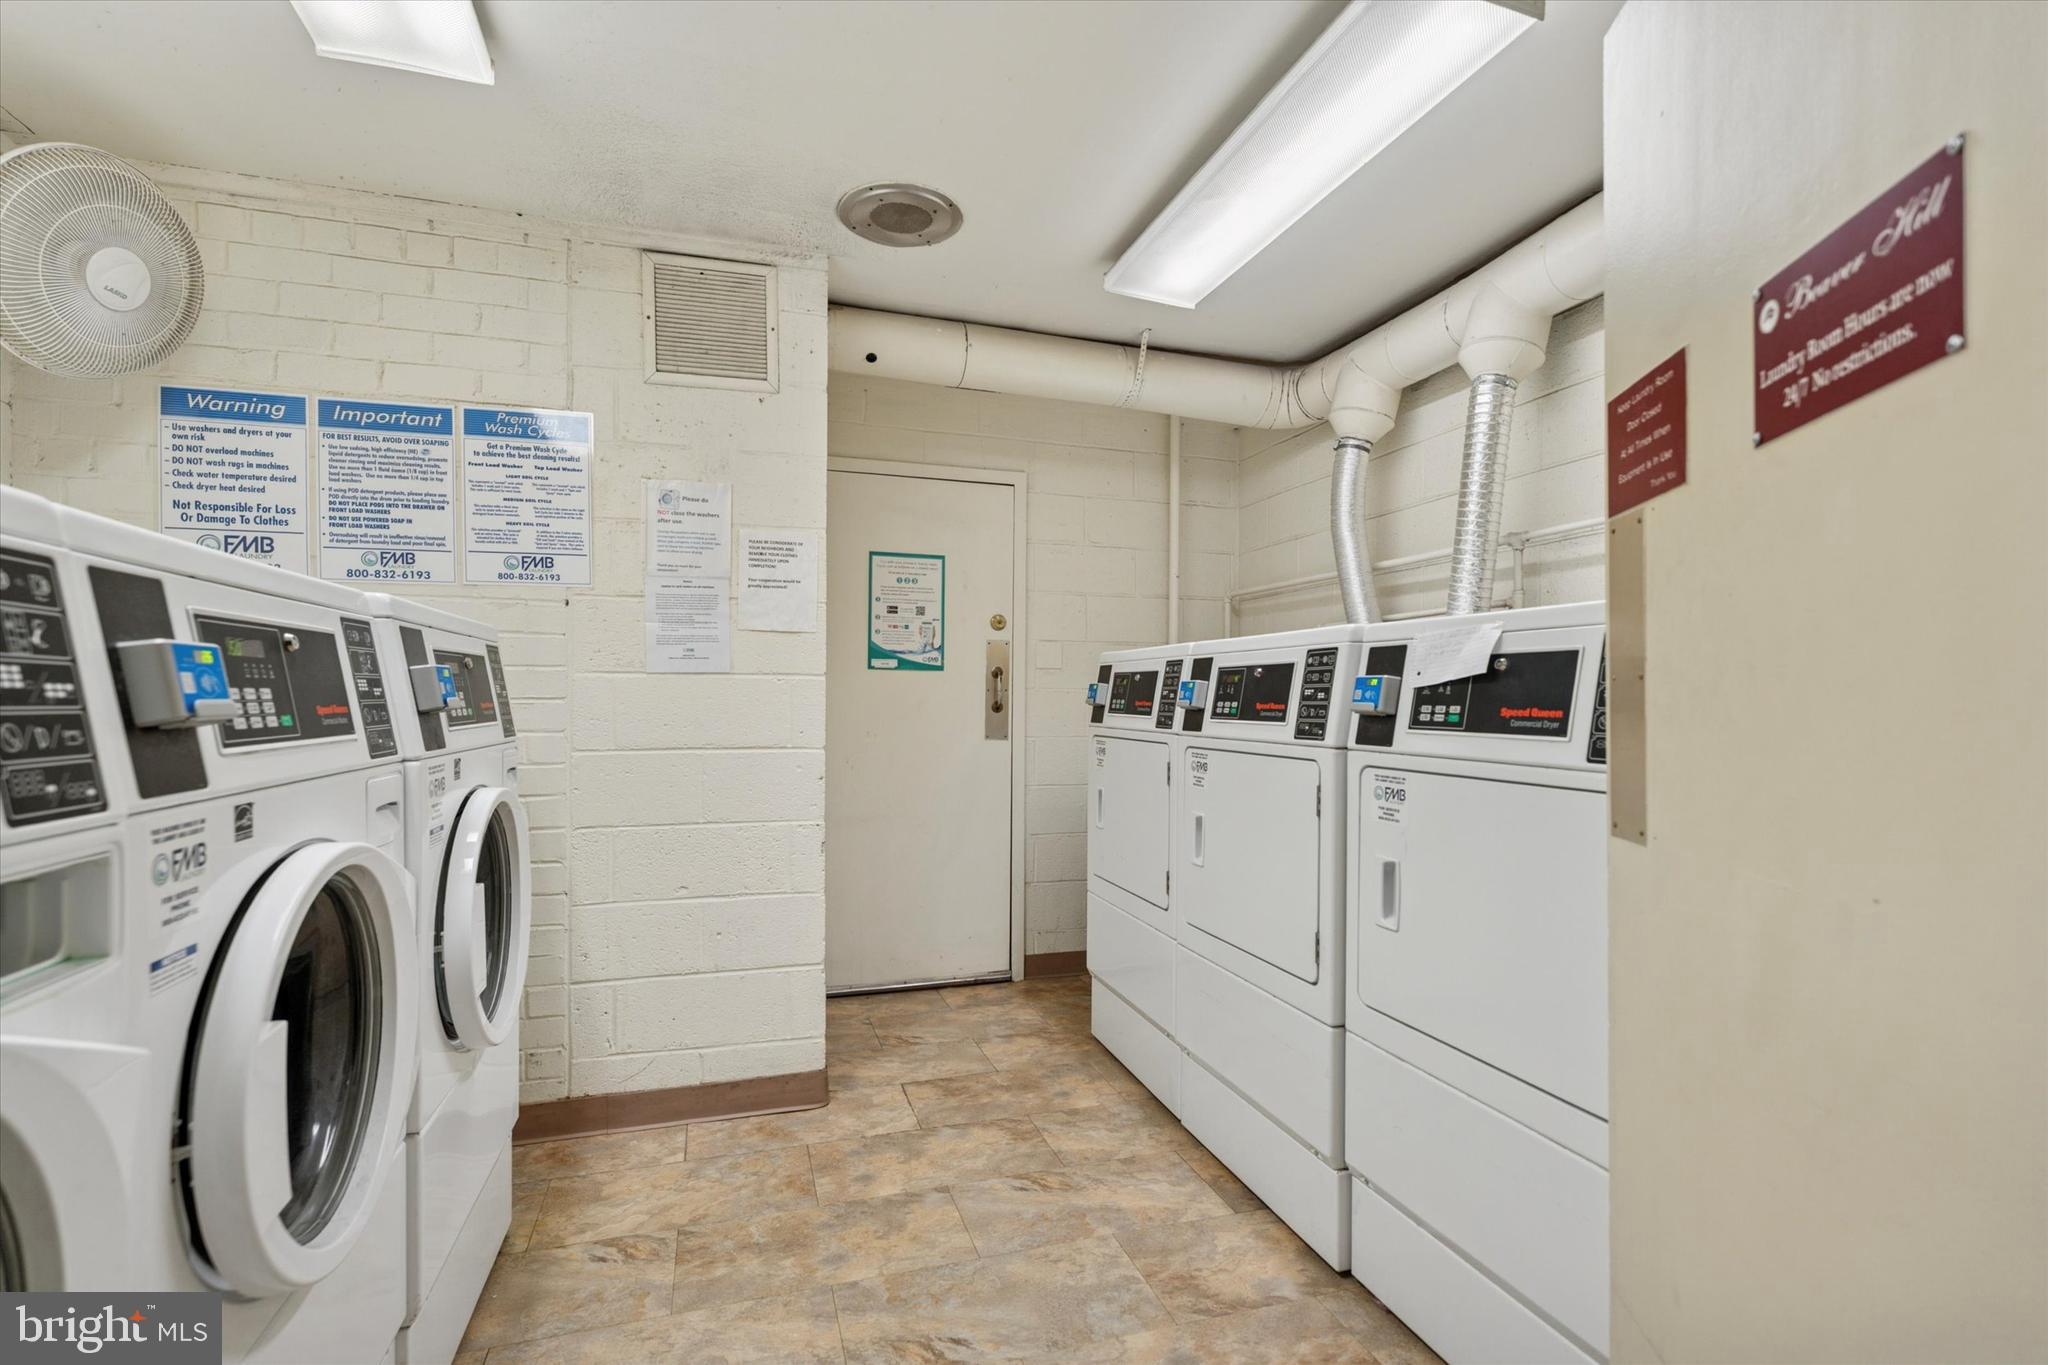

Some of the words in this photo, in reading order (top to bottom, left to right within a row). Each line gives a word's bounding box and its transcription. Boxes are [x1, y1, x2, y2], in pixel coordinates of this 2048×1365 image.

[1784, 251, 1866, 320] Beaver
[1872, 174, 1952, 257] Hill
[1760, 349, 1805, 389] Laundry
[1807, 325, 1844, 360] Room
[1844, 299, 1887, 337] Hours
[1889, 282, 1915, 312] are
[1915, 258, 1955, 296] now
[1783, 376, 1809, 408] 24/7
[1812, 367, 1832, 392] No
[1831, 322, 1917, 382] restrictions.
[187, 393, 286, 419] Warning
[334, 406, 442, 427] Important
[497, 412, 559, 426] Premium
[172, 423, 187, 431] Use
[189, 425, 220, 433] washers
[239, 428, 263, 437] dryers
[276, 431, 292, 439] your
[485, 422, 521, 435] Wash
[354, 435, 380, 443] RESULTS,
[186, 445, 203, 453] NOT
[206, 447, 238, 455] overload
[240, 449, 274, 457] machines
[532, 454, 556, 462] cleaning
[552, 447, 567, 455] Cycle
[206, 459, 225, 467] wash
[256, 462, 289, 470] machines
[172, 469, 193, 477] Check
[197, 470, 219, 479] water
[222, 472, 267, 483] temperature
[270, 474, 296, 483] desired
[172, 482, 194, 490] Check
[197, 483, 217, 492] dryer
[219, 484, 235, 492] heat
[238, 485, 265, 493] desired
[173, 500, 191, 509] Not
[195, 501, 253, 514] Responsible
[257, 504, 272, 513] For
[276, 505, 296, 514] Loss
[181, 512, 193, 522] Or
[197, 513, 236, 525] Damage
[240, 515, 250, 524] To
[254, 516, 289, 526] Clothes
[224, 535, 274, 553] FMB
[380, 552, 415, 567] FMB
[522, 556, 554, 571] FMB
[347, 569, 431, 579] 800-832-6193
[498, 573, 560, 581] 800-832-6193
[1500, 708, 1530, 719] Speed
[1531, 708, 1564, 718] Queen
[1543, 720, 1560, 729] Dryer
[1385, 787, 1406, 802] FMB
[172, 842, 207, 882] FMB
